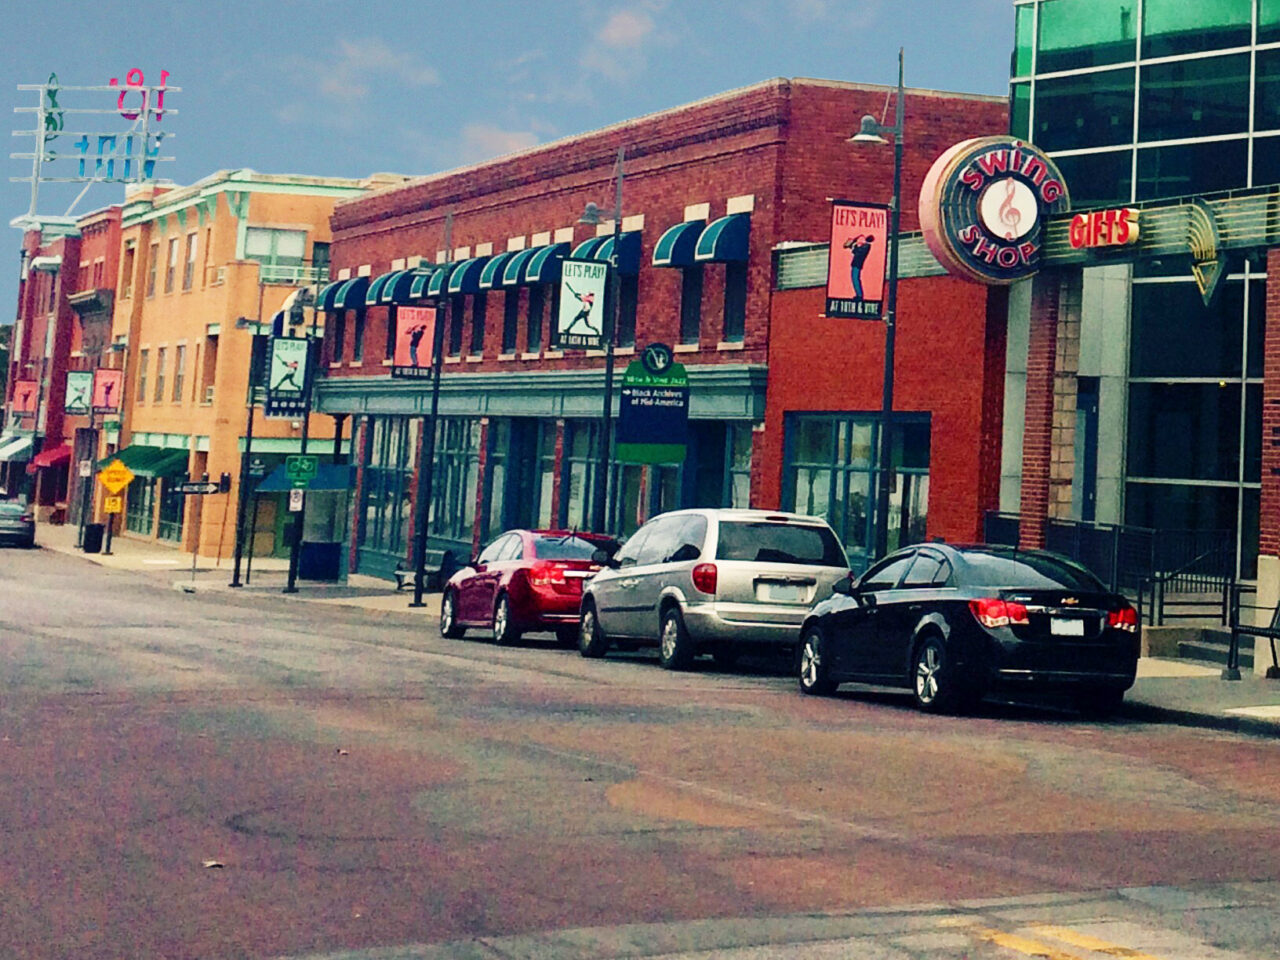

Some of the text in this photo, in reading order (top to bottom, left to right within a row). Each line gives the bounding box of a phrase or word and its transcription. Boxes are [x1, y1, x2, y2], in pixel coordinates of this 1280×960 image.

[835, 208, 884, 229] LET'S PLAY!
[1069, 207, 1140, 250] GIFTS
[959, 224, 1038, 268] SHOP
[631, 388, 683, 398] Black Archives
